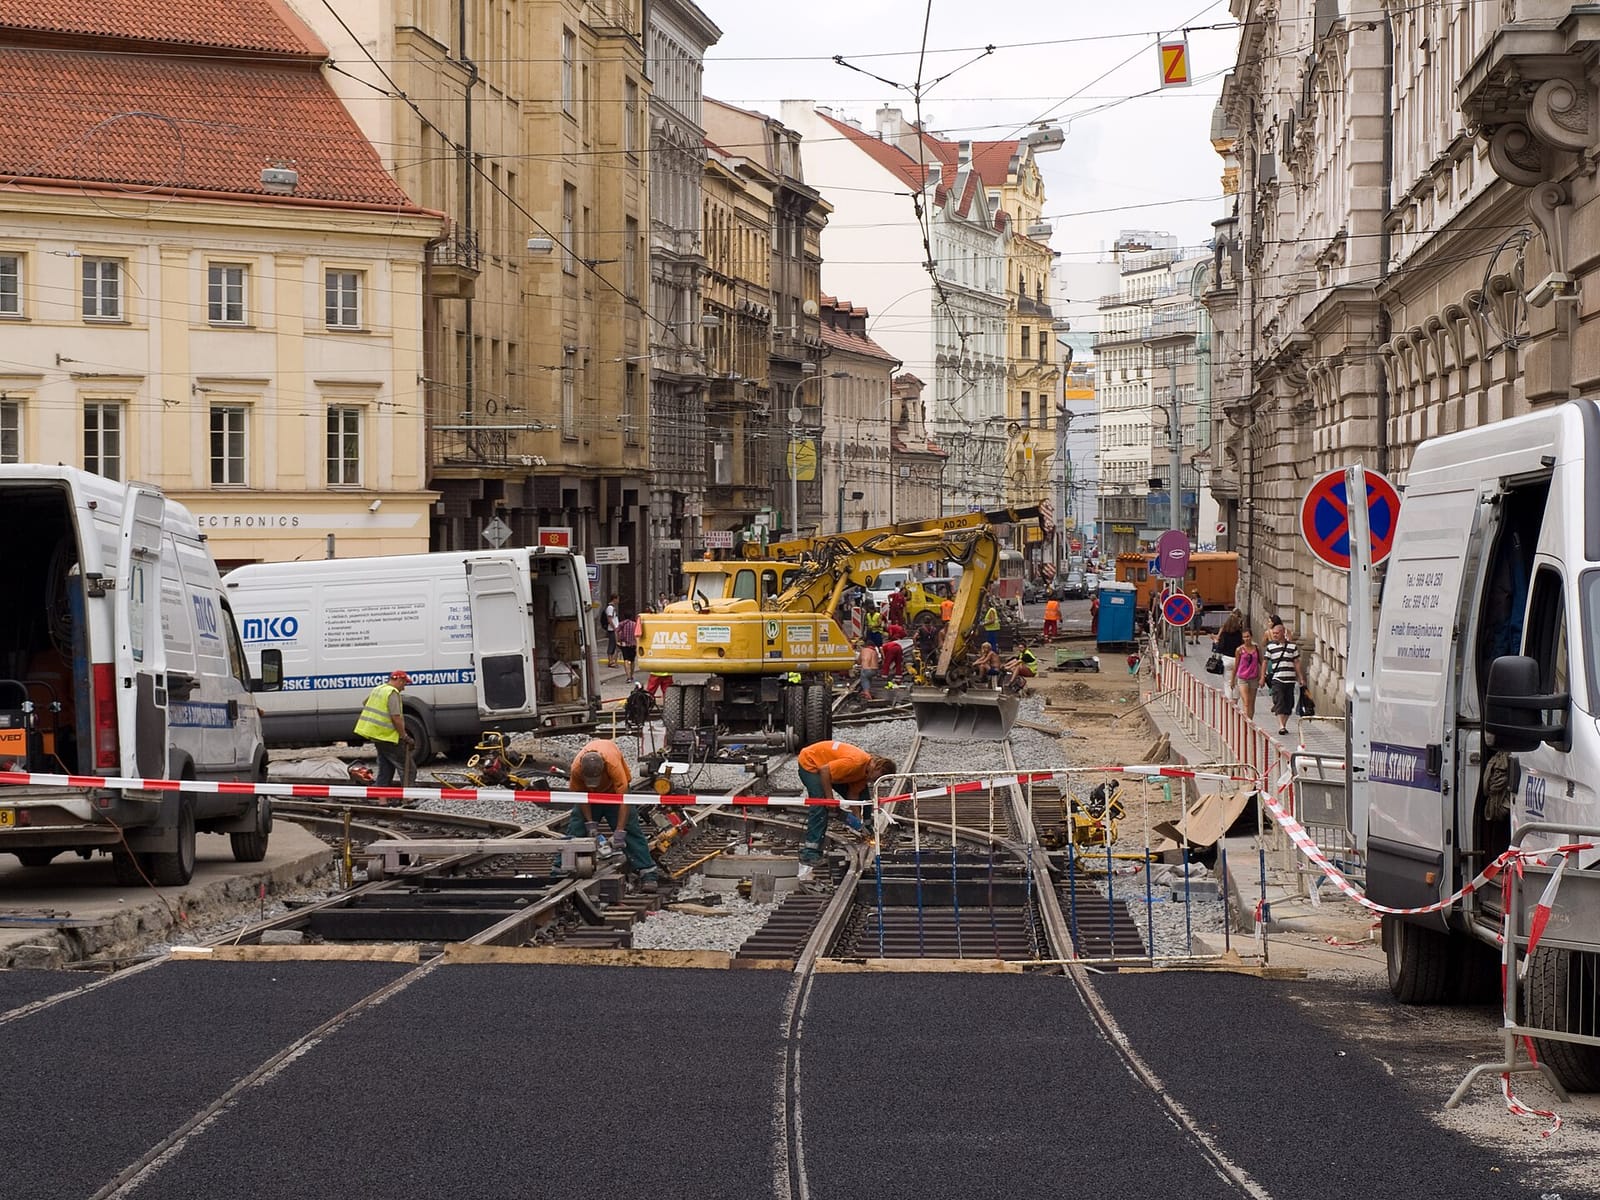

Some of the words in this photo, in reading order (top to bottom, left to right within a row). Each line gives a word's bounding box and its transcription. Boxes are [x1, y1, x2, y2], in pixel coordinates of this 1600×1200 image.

[1162, 45, 1187, 84] Z
[198, 516, 299, 527] ECTRONICS
[943, 521, 955, 530] AD
[957, 519, 968, 528] 20
[859, 558, 891, 571] ATLAS
[652, 631, 688, 644] ATLAS
[818, 644, 834, 655] ZW
[314, 674, 389, 689] KONSTRUKCE
[407, 670, 459, 685] OPRAVNÍ
[1388, 752, 1417, 782] STAVBY
